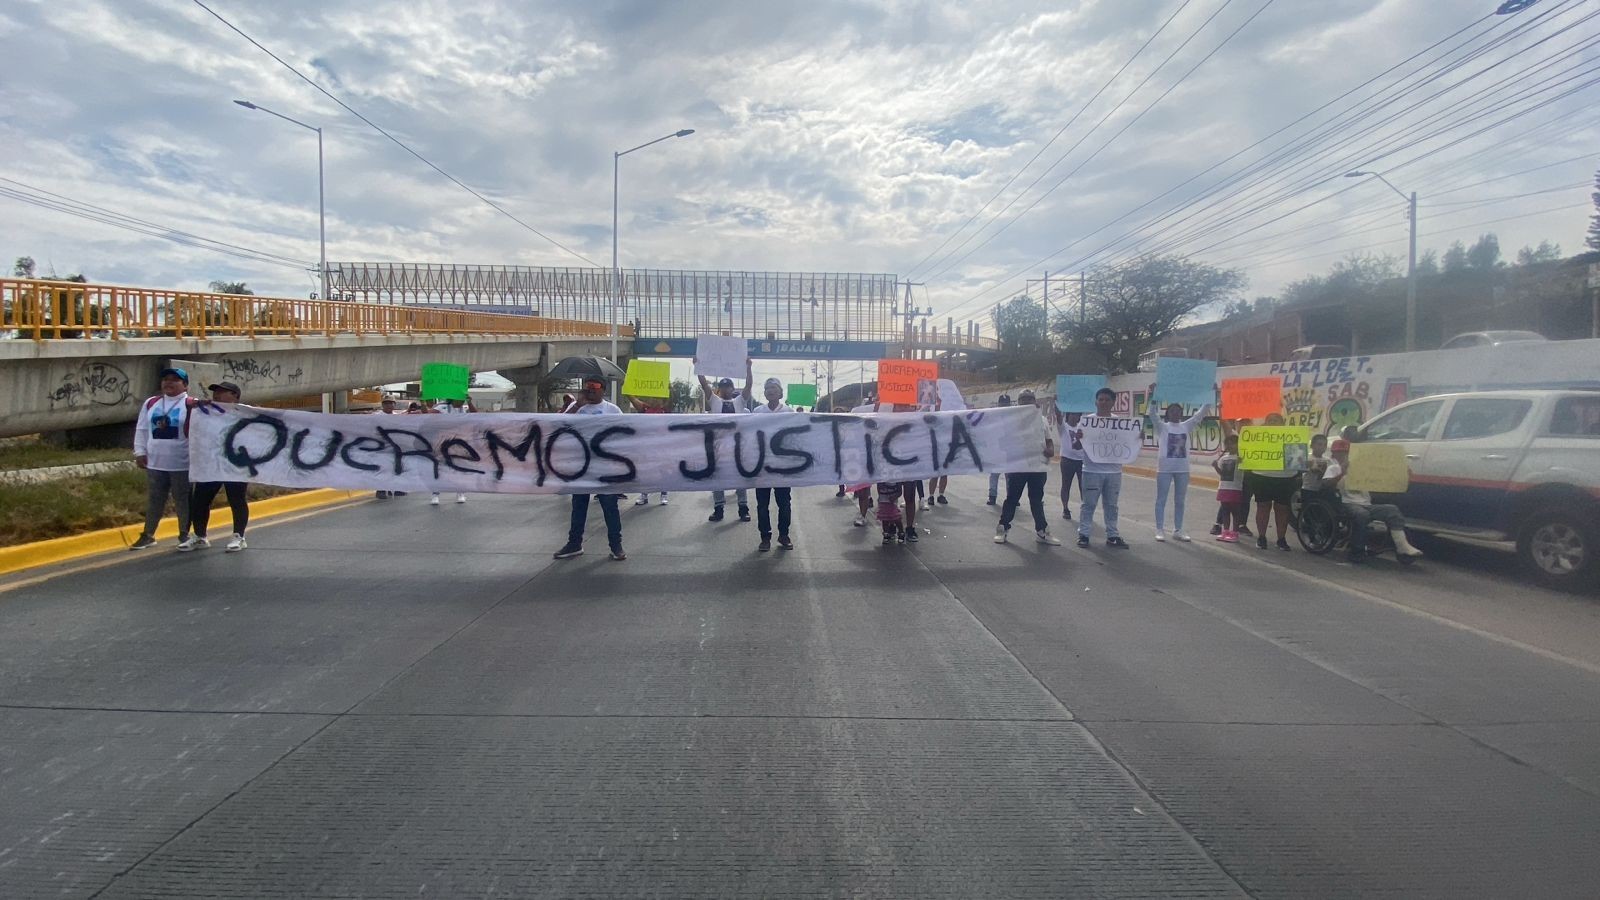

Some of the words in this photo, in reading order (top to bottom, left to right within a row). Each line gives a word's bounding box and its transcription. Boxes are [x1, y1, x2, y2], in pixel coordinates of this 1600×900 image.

[881, 363, 934, 379] QUEREMOS
[1270, 360, 1320, 374] PLAZA
[1325, 358, 1350, 371] DE
[1357, 357, 1373, 374] T.
[633, 379, 665, 390] JUSTICIA
[1283, 373, 1302, 388] LA
[1312, 371, 1355, 387] LUZ
[1082, 416, 1141, 431] JUSTICIA
[1242, 430, 1302, 443] QUEREMOS
